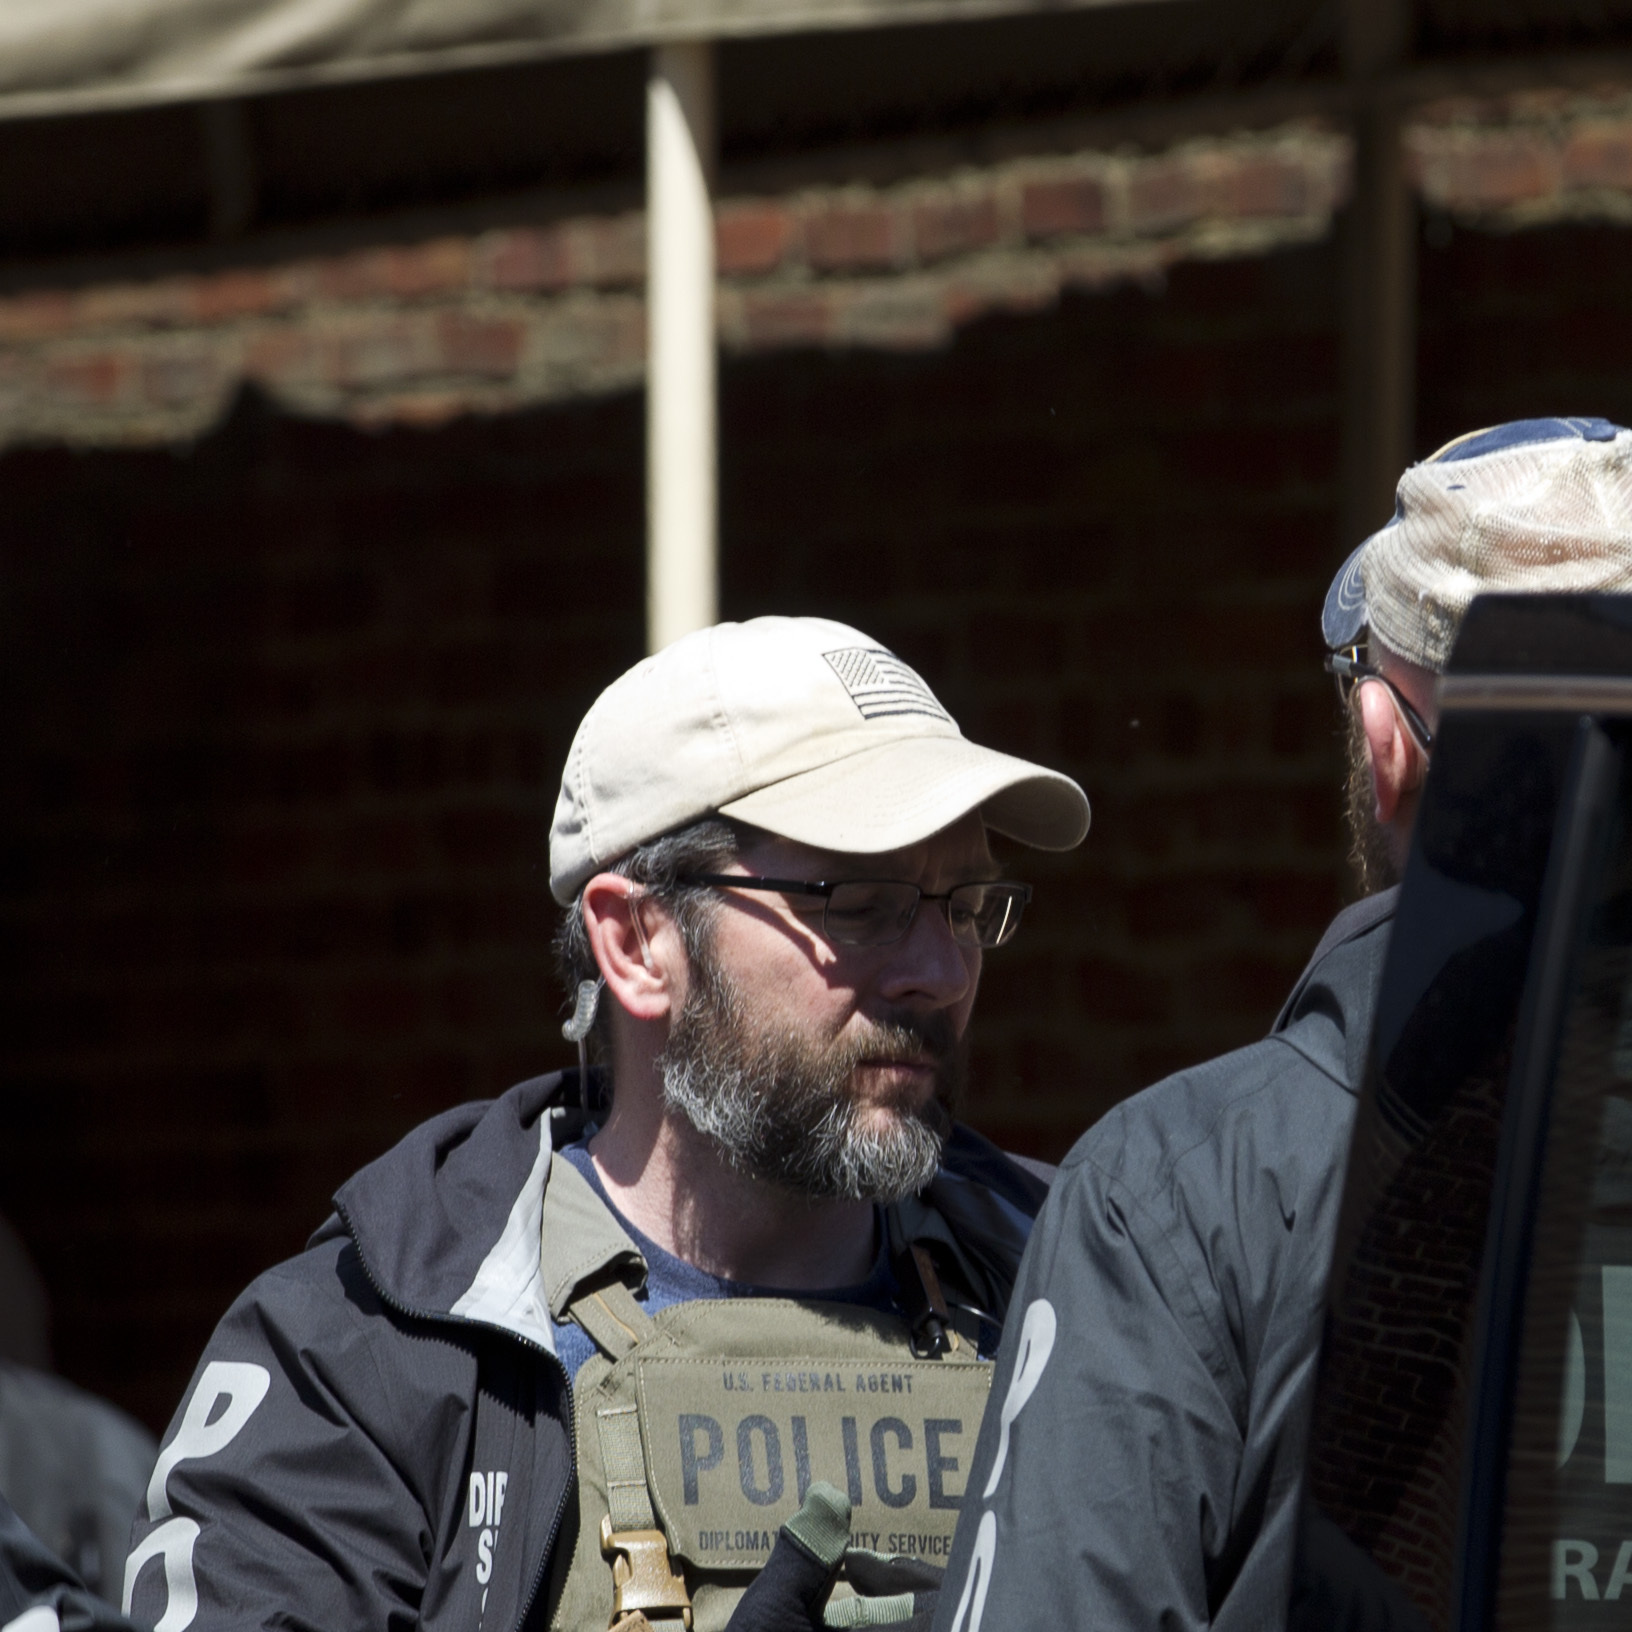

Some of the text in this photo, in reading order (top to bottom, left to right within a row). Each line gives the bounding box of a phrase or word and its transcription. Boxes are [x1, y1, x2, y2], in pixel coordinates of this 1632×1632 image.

[723, 1372, 914, 1394] U.S. FEDERAL AGENT
[678, 1413, 965, 1511] POLICE
[889, 1533, 952, 1556] SERVICE
